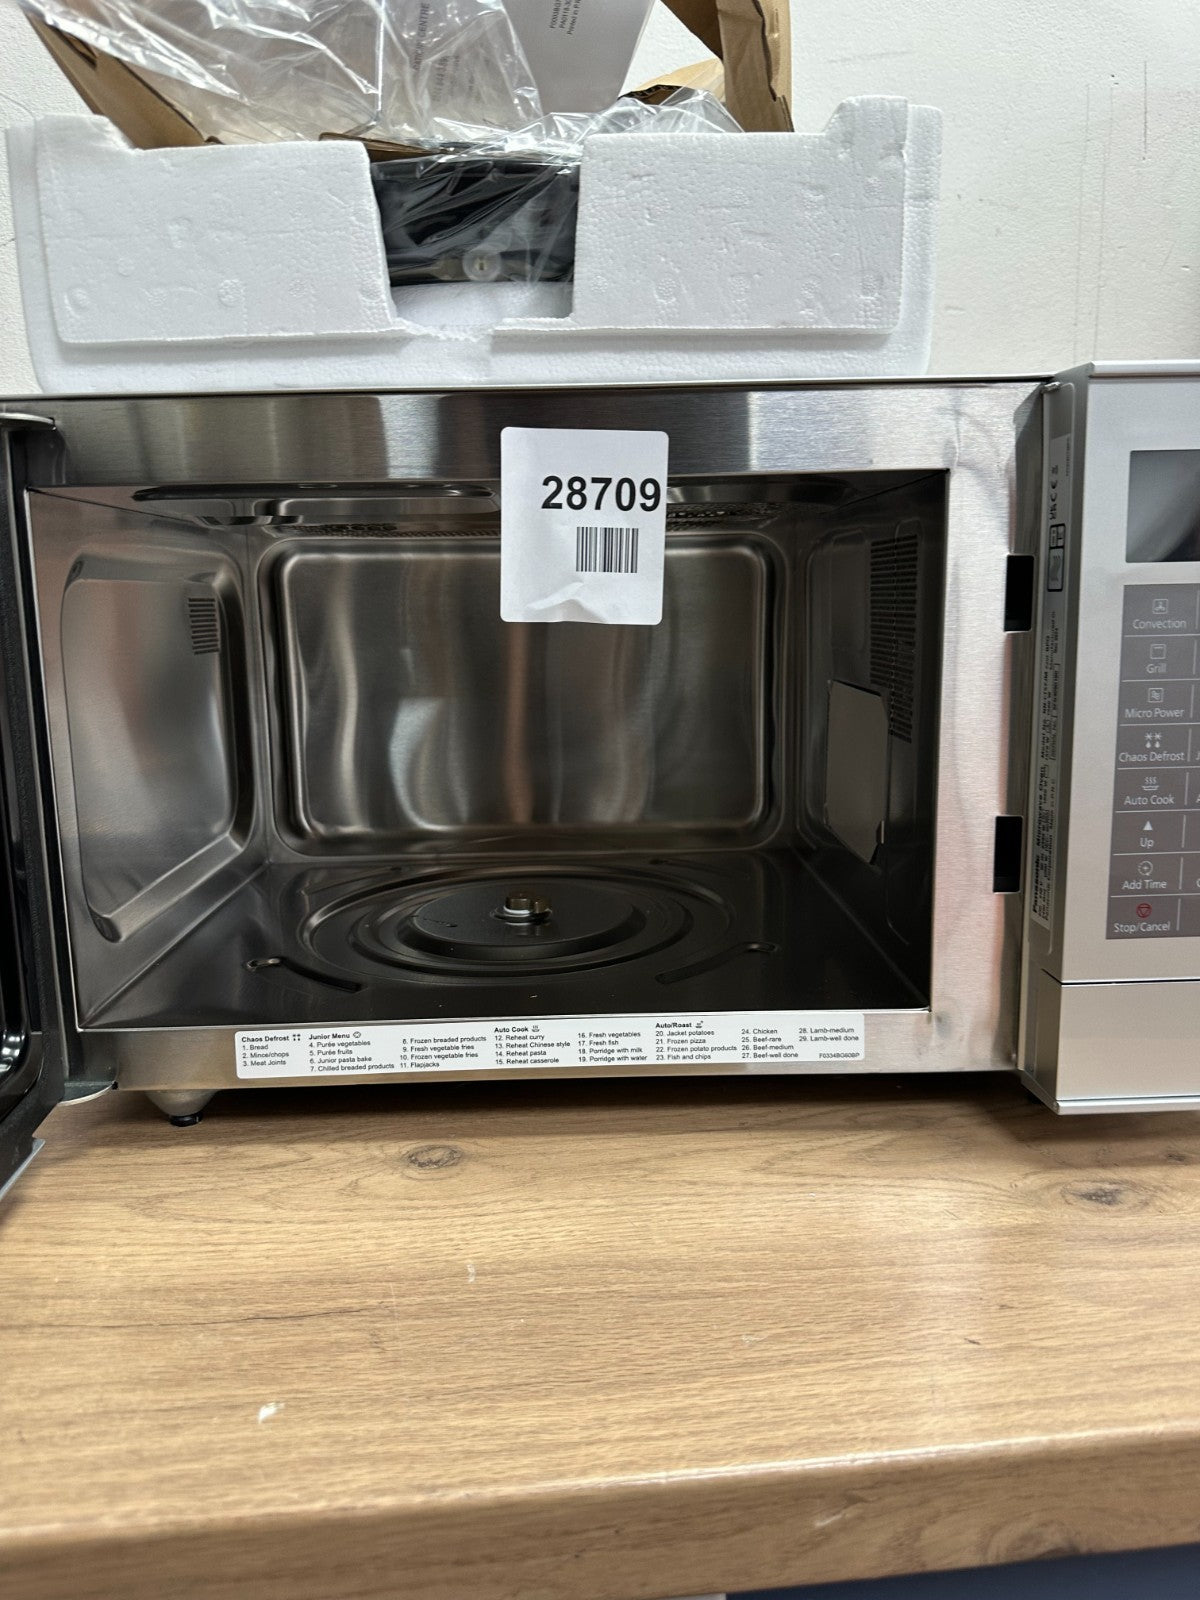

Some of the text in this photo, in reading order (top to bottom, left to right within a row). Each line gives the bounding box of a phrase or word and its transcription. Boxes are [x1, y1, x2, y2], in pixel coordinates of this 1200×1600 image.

[416, 3, 430, 38] CENTRE
[541, 476, 661, 512] 28709
[1132, 619, 1187, 629] Convection
[1146, 663, 1166, 673] Grill
[1125, 708, 1184, 718] Micro Power
[1119, 752, 1147, 762] Chaos
[1150, 751, 1184, 762] Defrost
[1124, 795, 1174, 805] Auto Cook
[1140, 838, 1154, 848] Up
[1122, 879, 1167, 889] Add Time
[1114, 922, 1170, 933] Stop/Cancel
